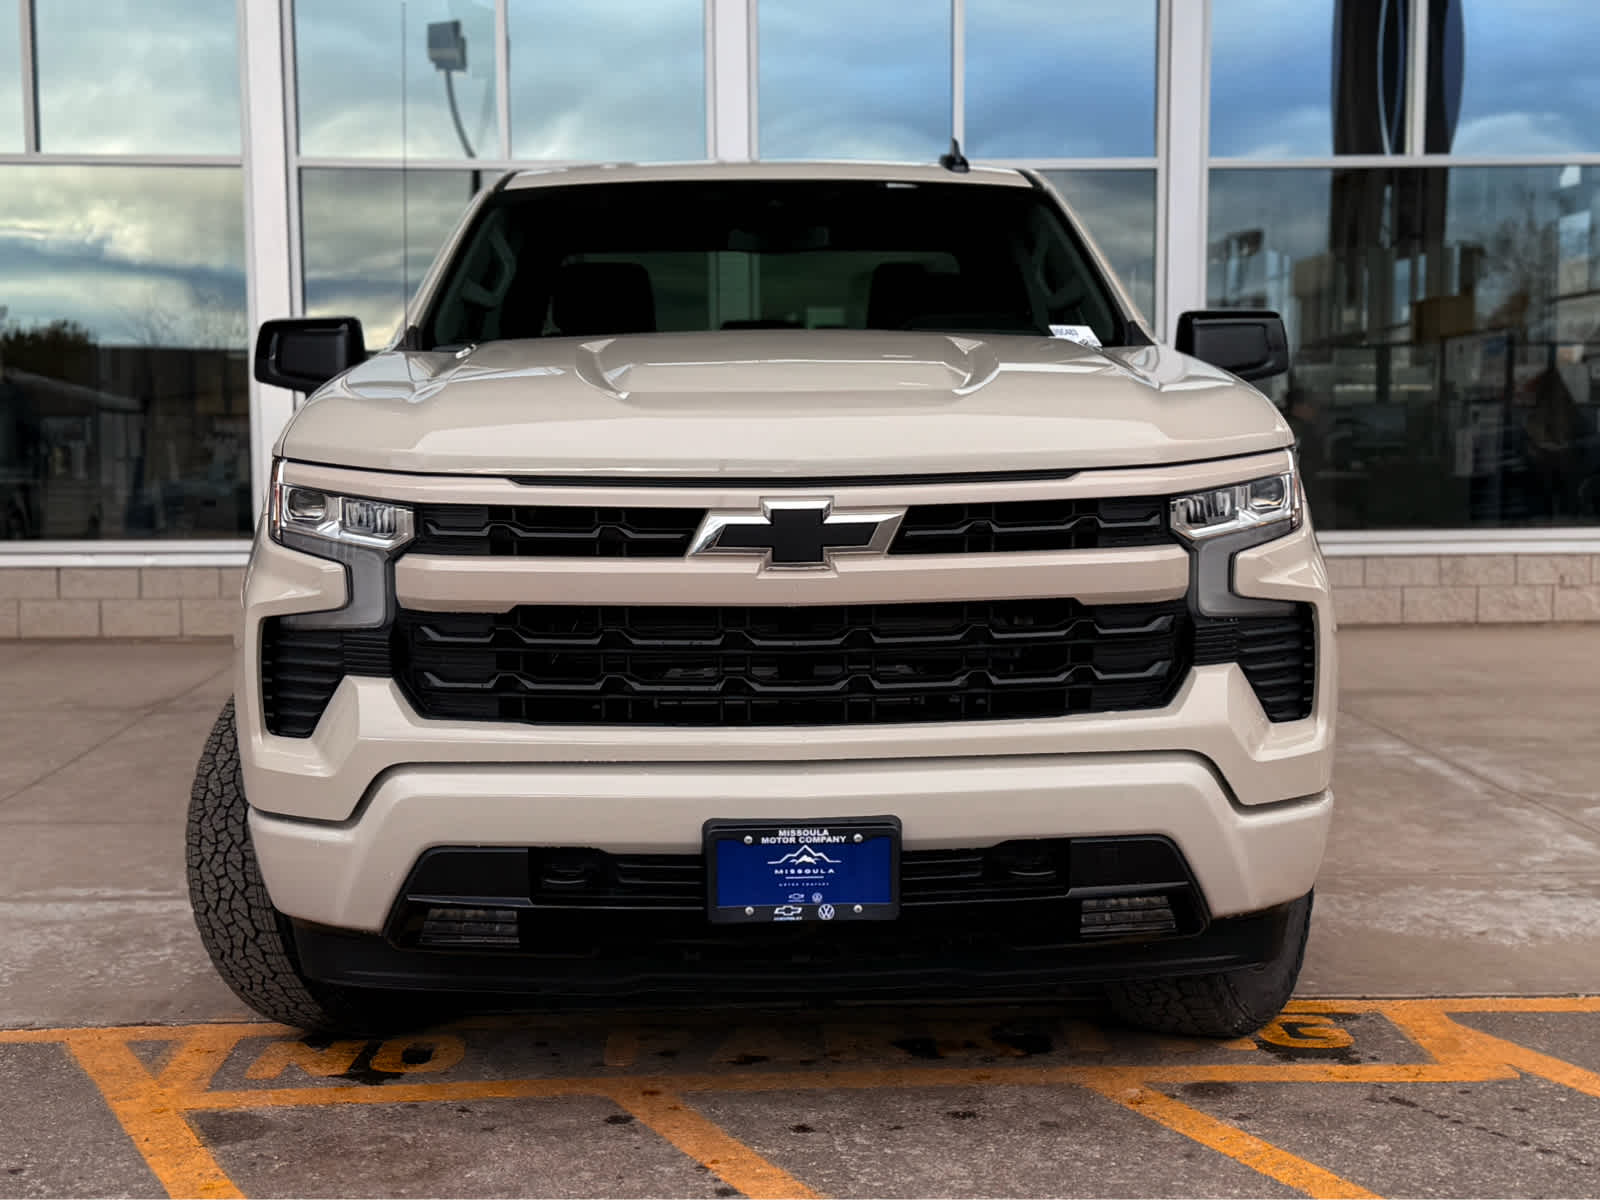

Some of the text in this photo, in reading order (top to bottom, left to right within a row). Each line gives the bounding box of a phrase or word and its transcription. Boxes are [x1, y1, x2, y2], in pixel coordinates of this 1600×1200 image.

[778, 829, 829, 837] MISSOULA
[761, 835, 847, 844] MOTOR COMPANY
[245, 1036, 465, 1080] NO
